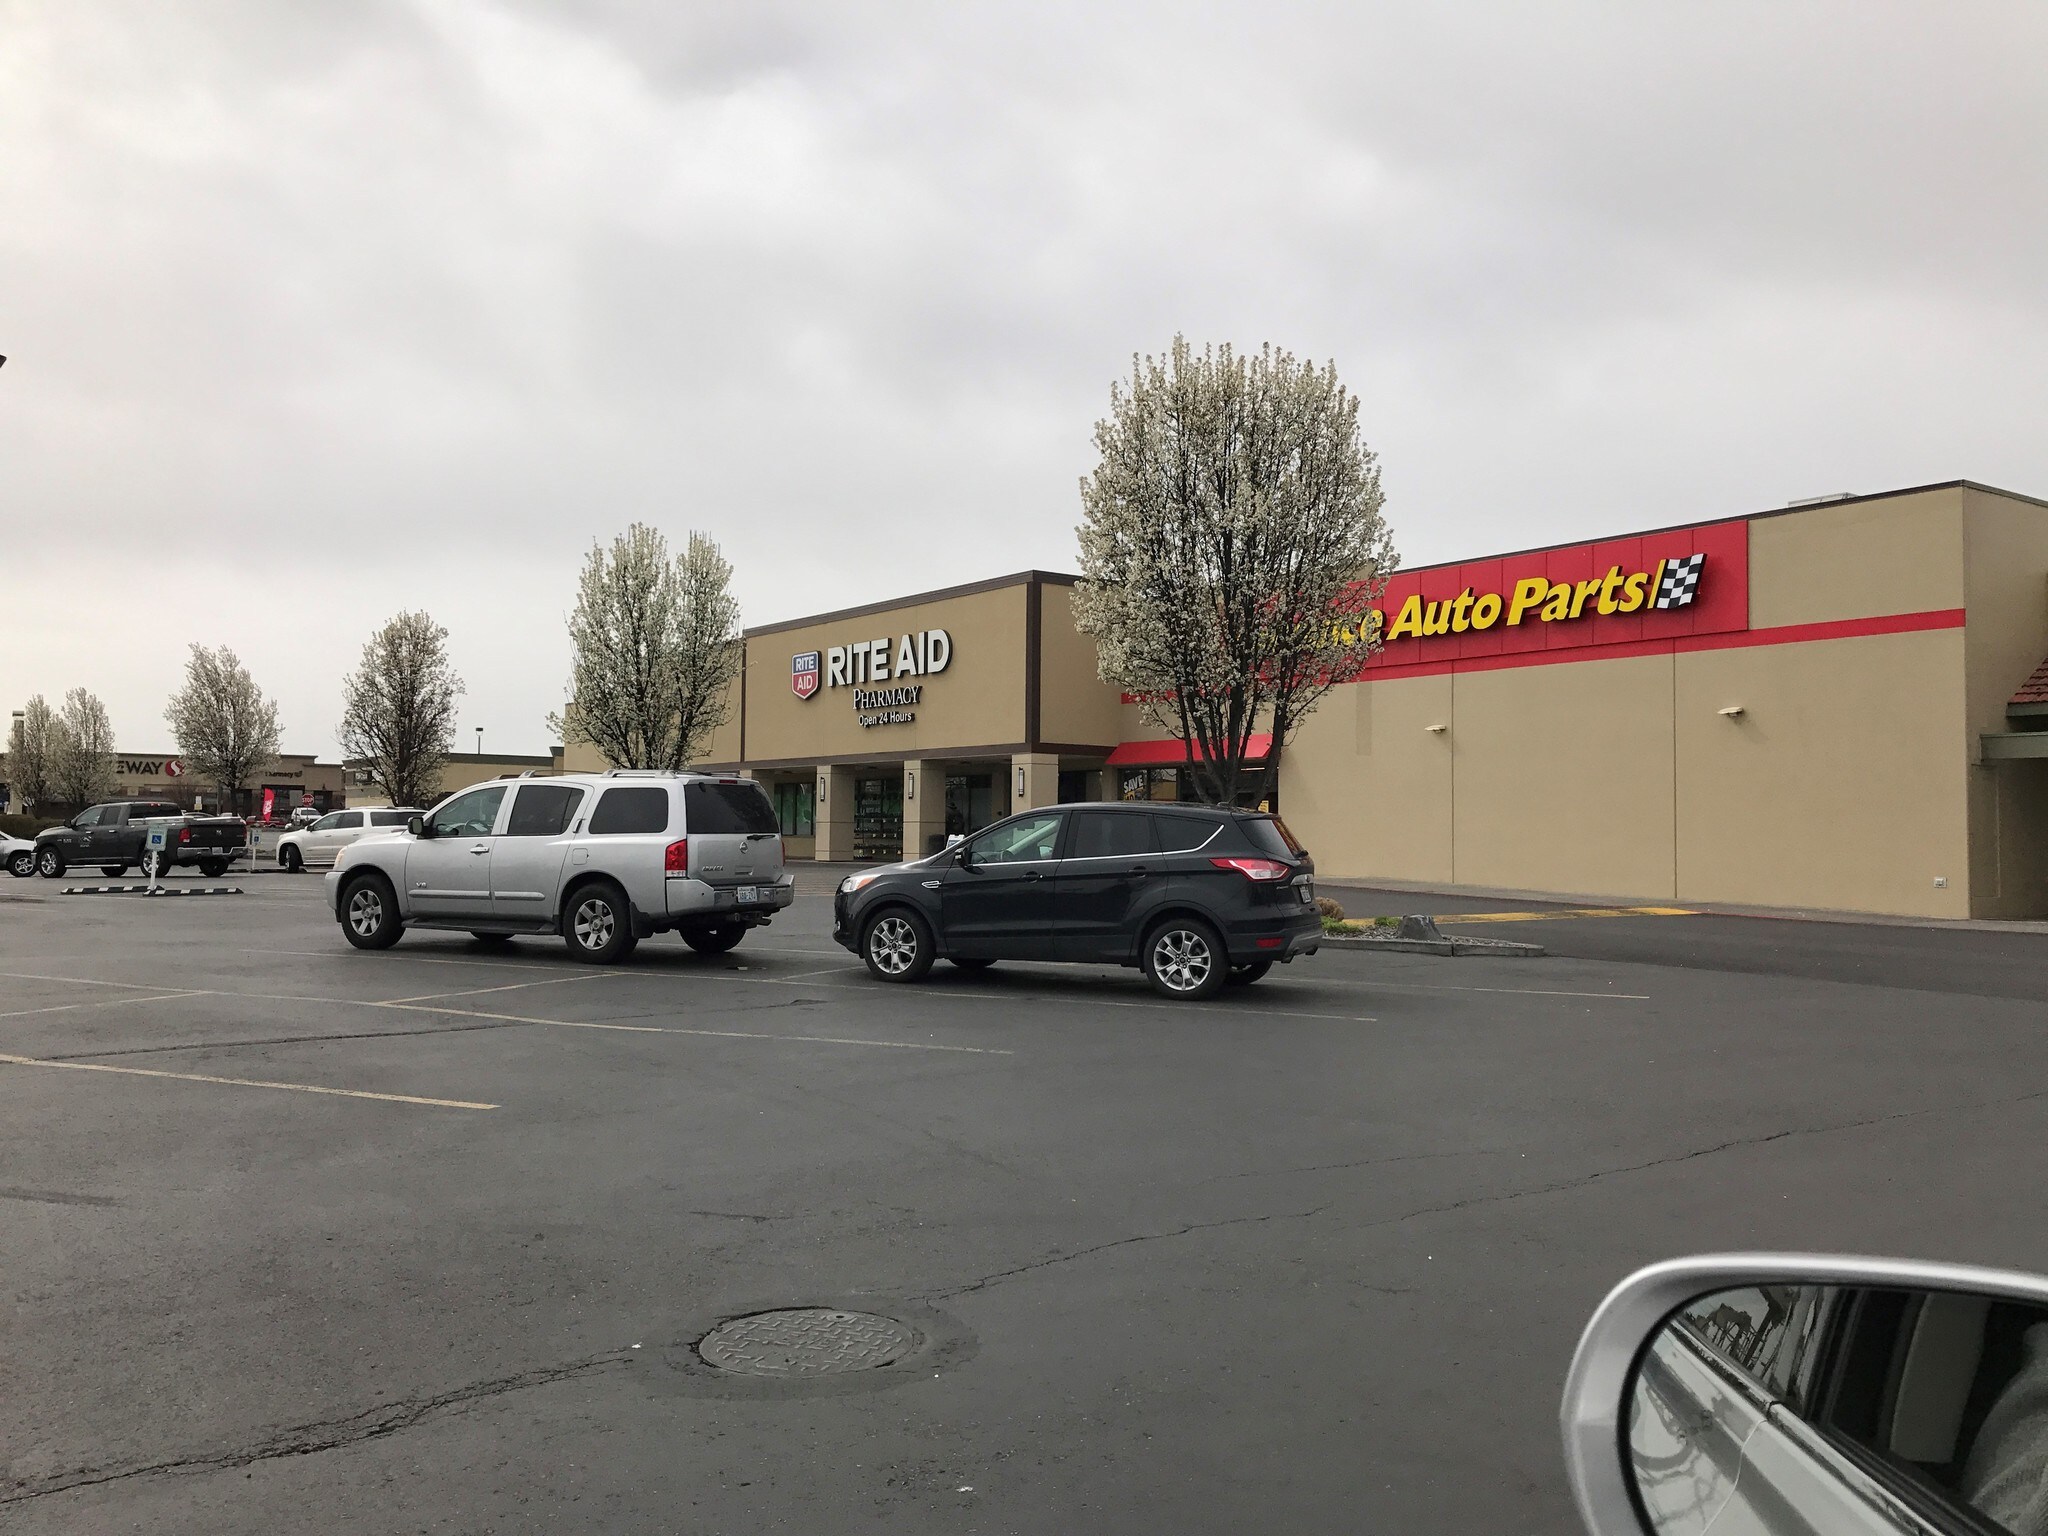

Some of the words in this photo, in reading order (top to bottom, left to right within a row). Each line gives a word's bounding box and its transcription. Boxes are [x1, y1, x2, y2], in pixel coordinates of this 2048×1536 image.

[1386, 587, 1503, 640] Auto
[1506, 565, 1650, 627] Parts
[795, 656, 815, 672] RITE
[827, 637, 891, 687] RITE
[894, 629, 951, 678] AID
[797, 675, 813, 691] AID
[852, 686, 919, 710] PHARMACY
[858, 714, 878, 728] Open
[879, 711, 889, 724] 24
[890, 711, 912, 723] Hours
[116, 760, 163, 775] EWAY
[1123, 774, 1144, 794] SAVE
